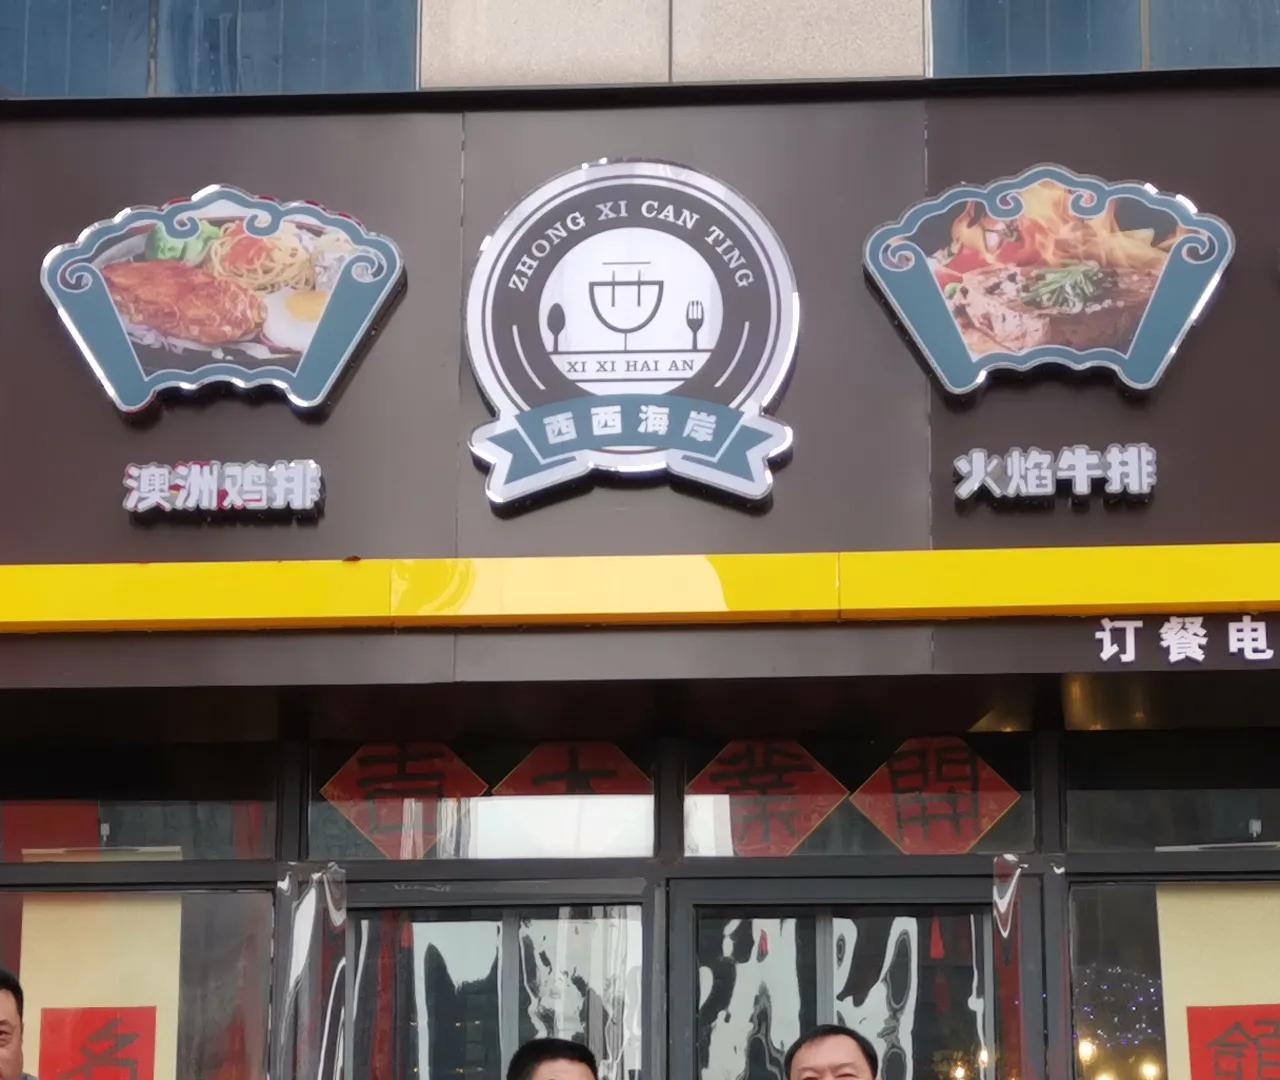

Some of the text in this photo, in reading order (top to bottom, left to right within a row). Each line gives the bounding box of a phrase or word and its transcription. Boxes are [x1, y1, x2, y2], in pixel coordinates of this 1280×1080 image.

[508, 200, 755, 292] ZHONG XI CAN TING
[566, 359, 695, 373] XI XI HAI AN
[543, 405, 718, 445] 西西海岸
[123, 459, 322, 513] 澳洲鸡排
[953, 443, 1157, 499] 火焰牛排
